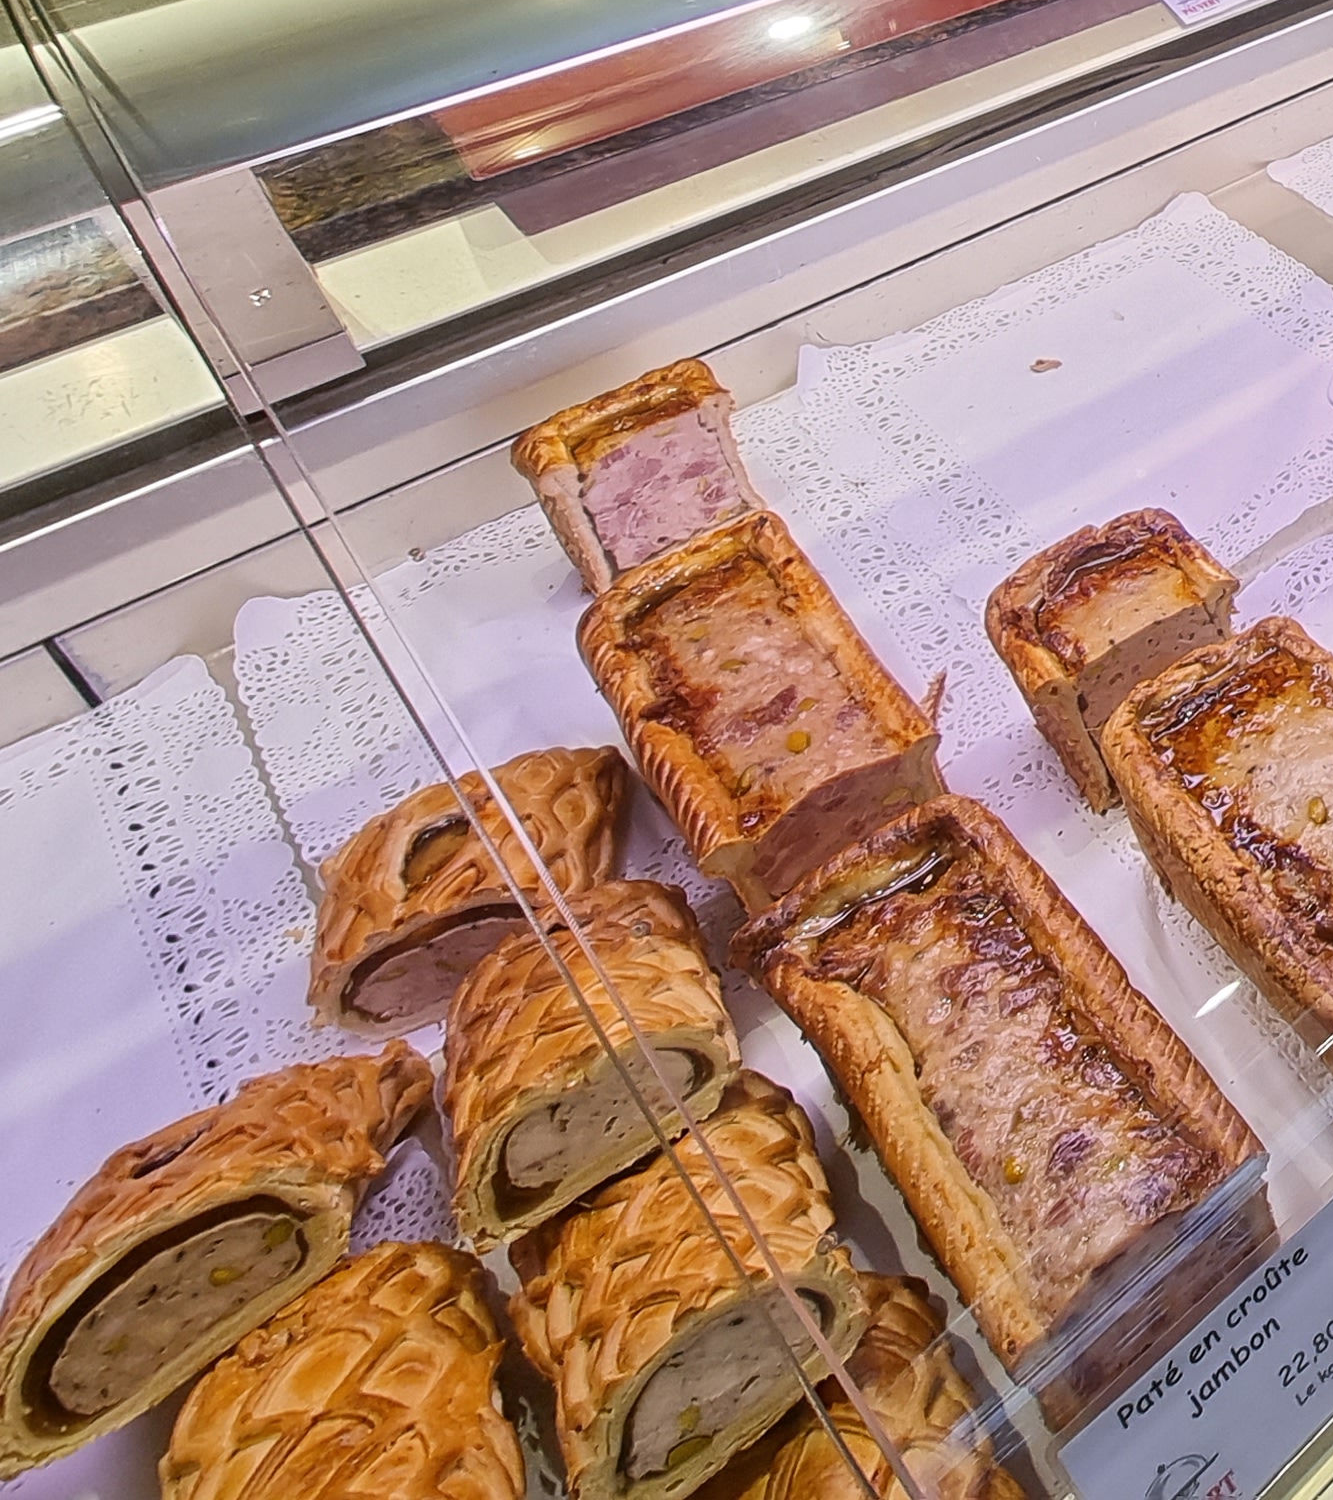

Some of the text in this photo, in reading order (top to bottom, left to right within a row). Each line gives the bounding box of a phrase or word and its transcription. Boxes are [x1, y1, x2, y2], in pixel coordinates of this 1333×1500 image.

[1115, 1245, 1310, 1430] Paté en croûte
[1186, 1315, 1282, 1420] jambon
[1293, 1382, 1317, 1408] Le
